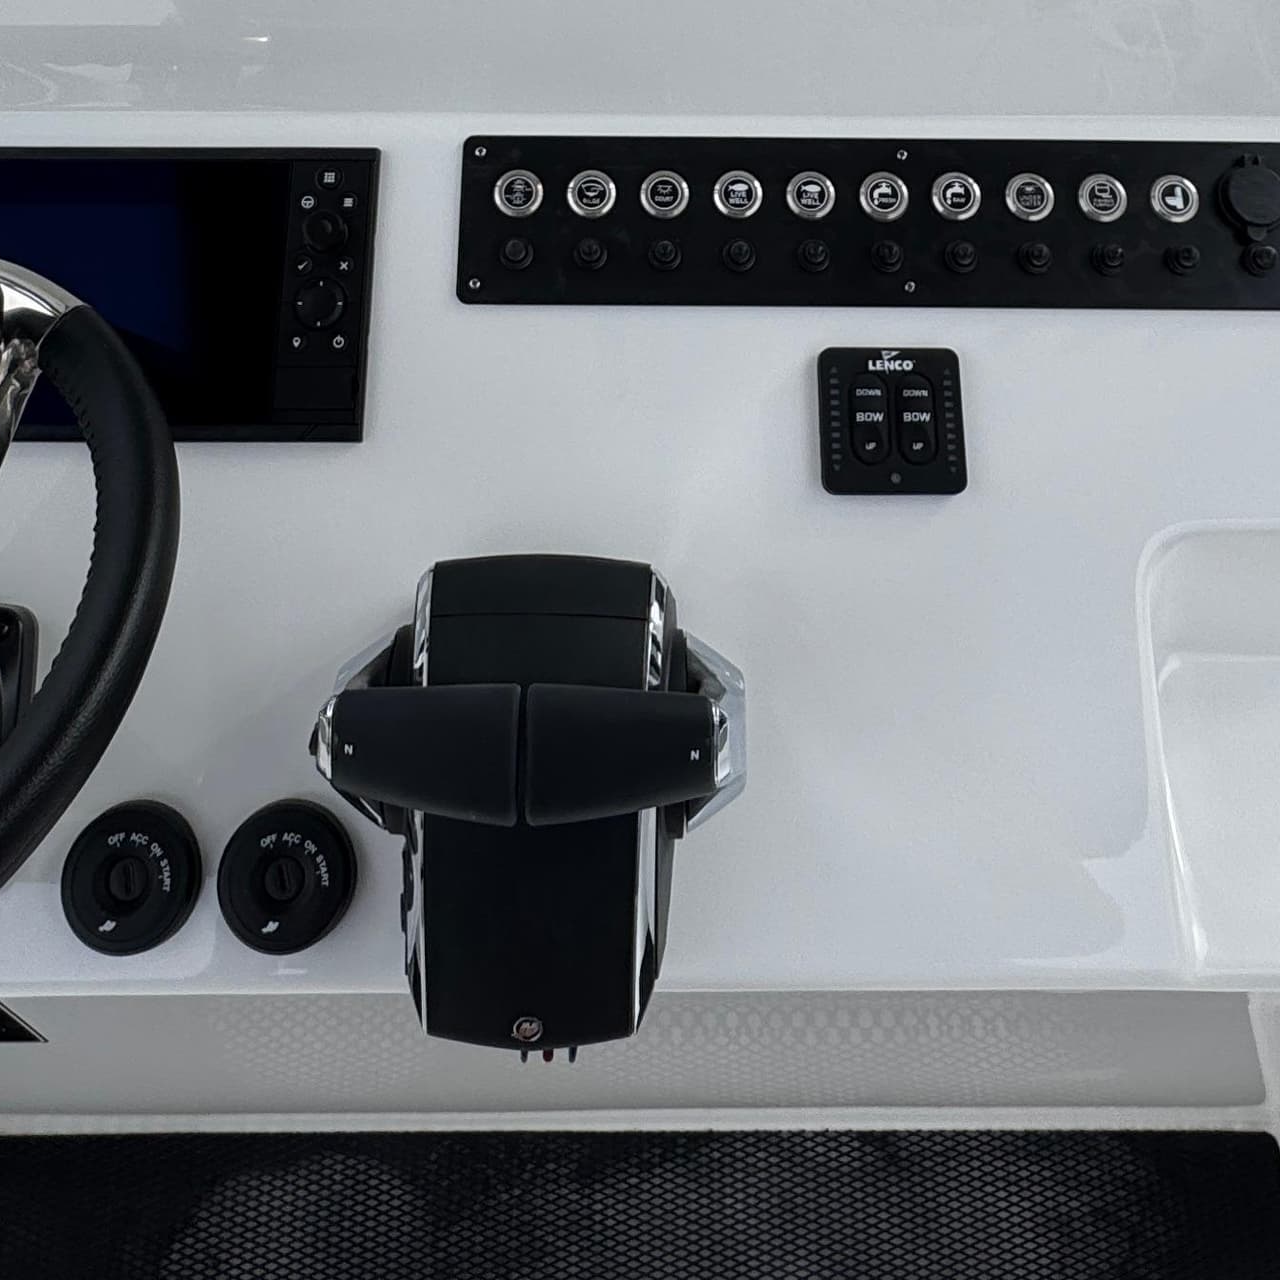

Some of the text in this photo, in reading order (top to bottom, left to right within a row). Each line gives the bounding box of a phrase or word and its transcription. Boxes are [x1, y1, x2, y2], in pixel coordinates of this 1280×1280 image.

[868, 360, 914, 372] LENCO
[856, 389, 882, 397] DOWN
[903, 389, 929, 397] DOWN
[856, 412, 884, 422] BOW
[903, 412, 931, 422] BOW
[865, 442, 877, 450] UP
[913, 442, 924, 450] UP
[344, 743, 353, 755] N
[690, 749, 700, 761] N
[108, 832, 171, 892] OFF ACC ON START
[261, 832, 329, 887] OFF ACC ON START
